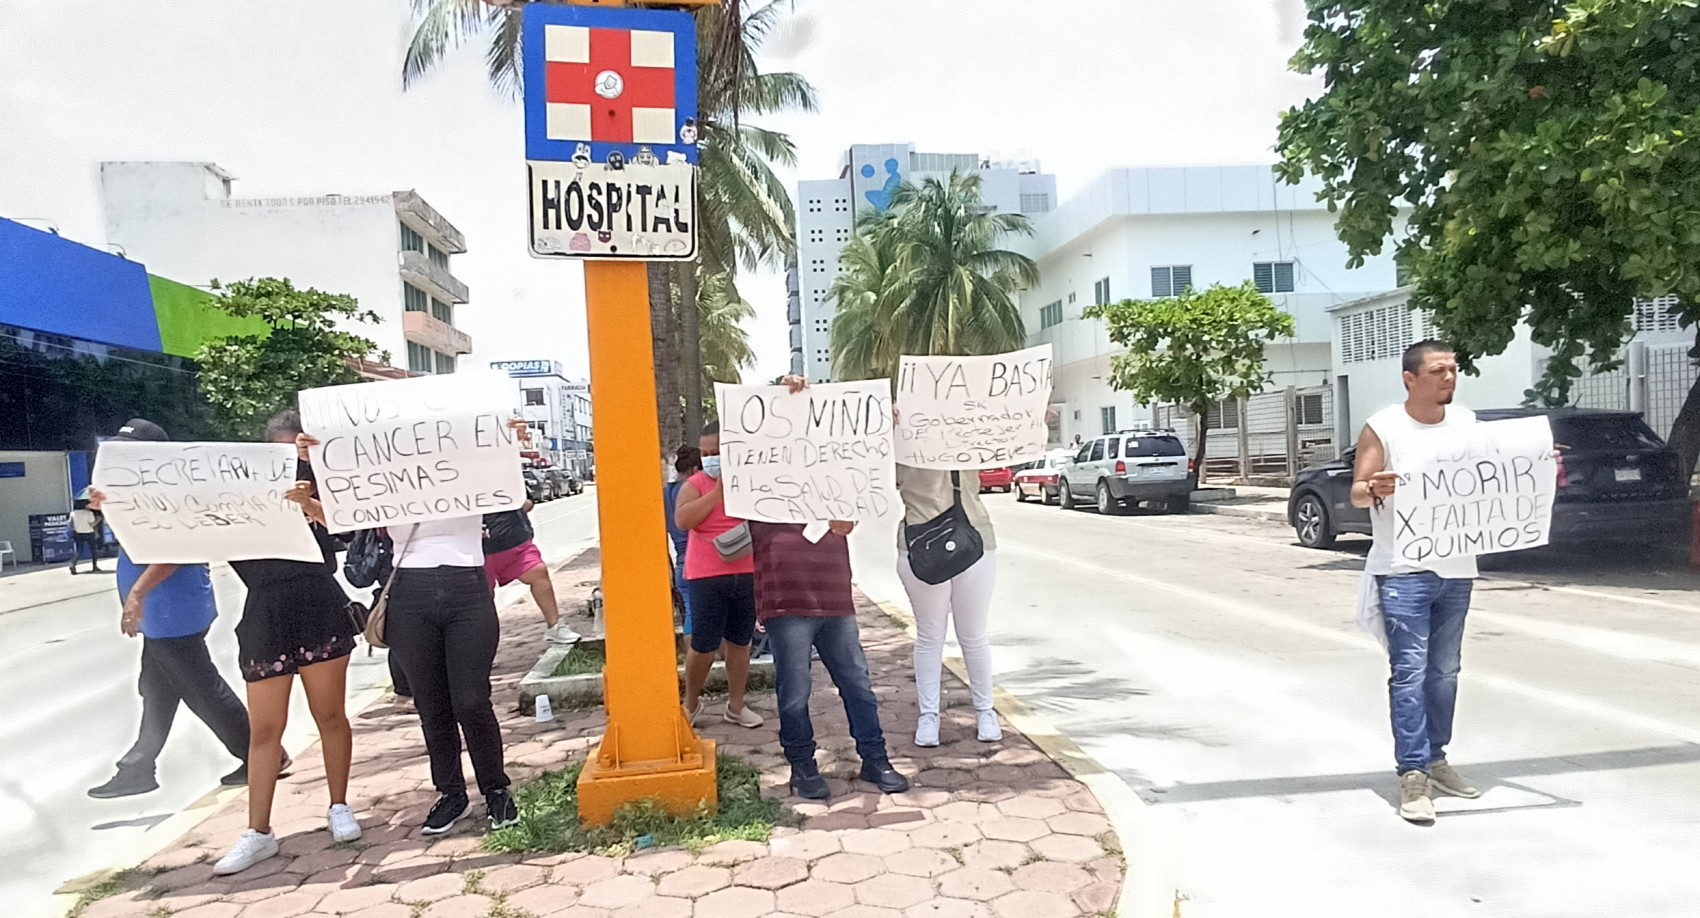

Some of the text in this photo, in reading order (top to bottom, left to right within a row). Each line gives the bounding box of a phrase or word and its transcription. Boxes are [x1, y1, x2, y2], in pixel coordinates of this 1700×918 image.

[298, 197, 314, 206] POR
[317, 196, 337, 206] PISO
[541, 179, 689, 233] HOSPITAL
[722, 389, 891, 438] LOS NIÑOS
[908, 405, 1033, 428] Gobernador
[322, 414, 513, 473] CANCER EN
[325, 460, 459, 504] PESIMAS
[730, 474, 740, 493] A
[845, 467, 884, 494] DE
[332, 489, 514, 527] CONDICIONES
[754, 491, 888, 521] CALIDAD
[1515, 493, 1548, 522] DE
[1402, 521, 1541, 562] QUIMIOS
